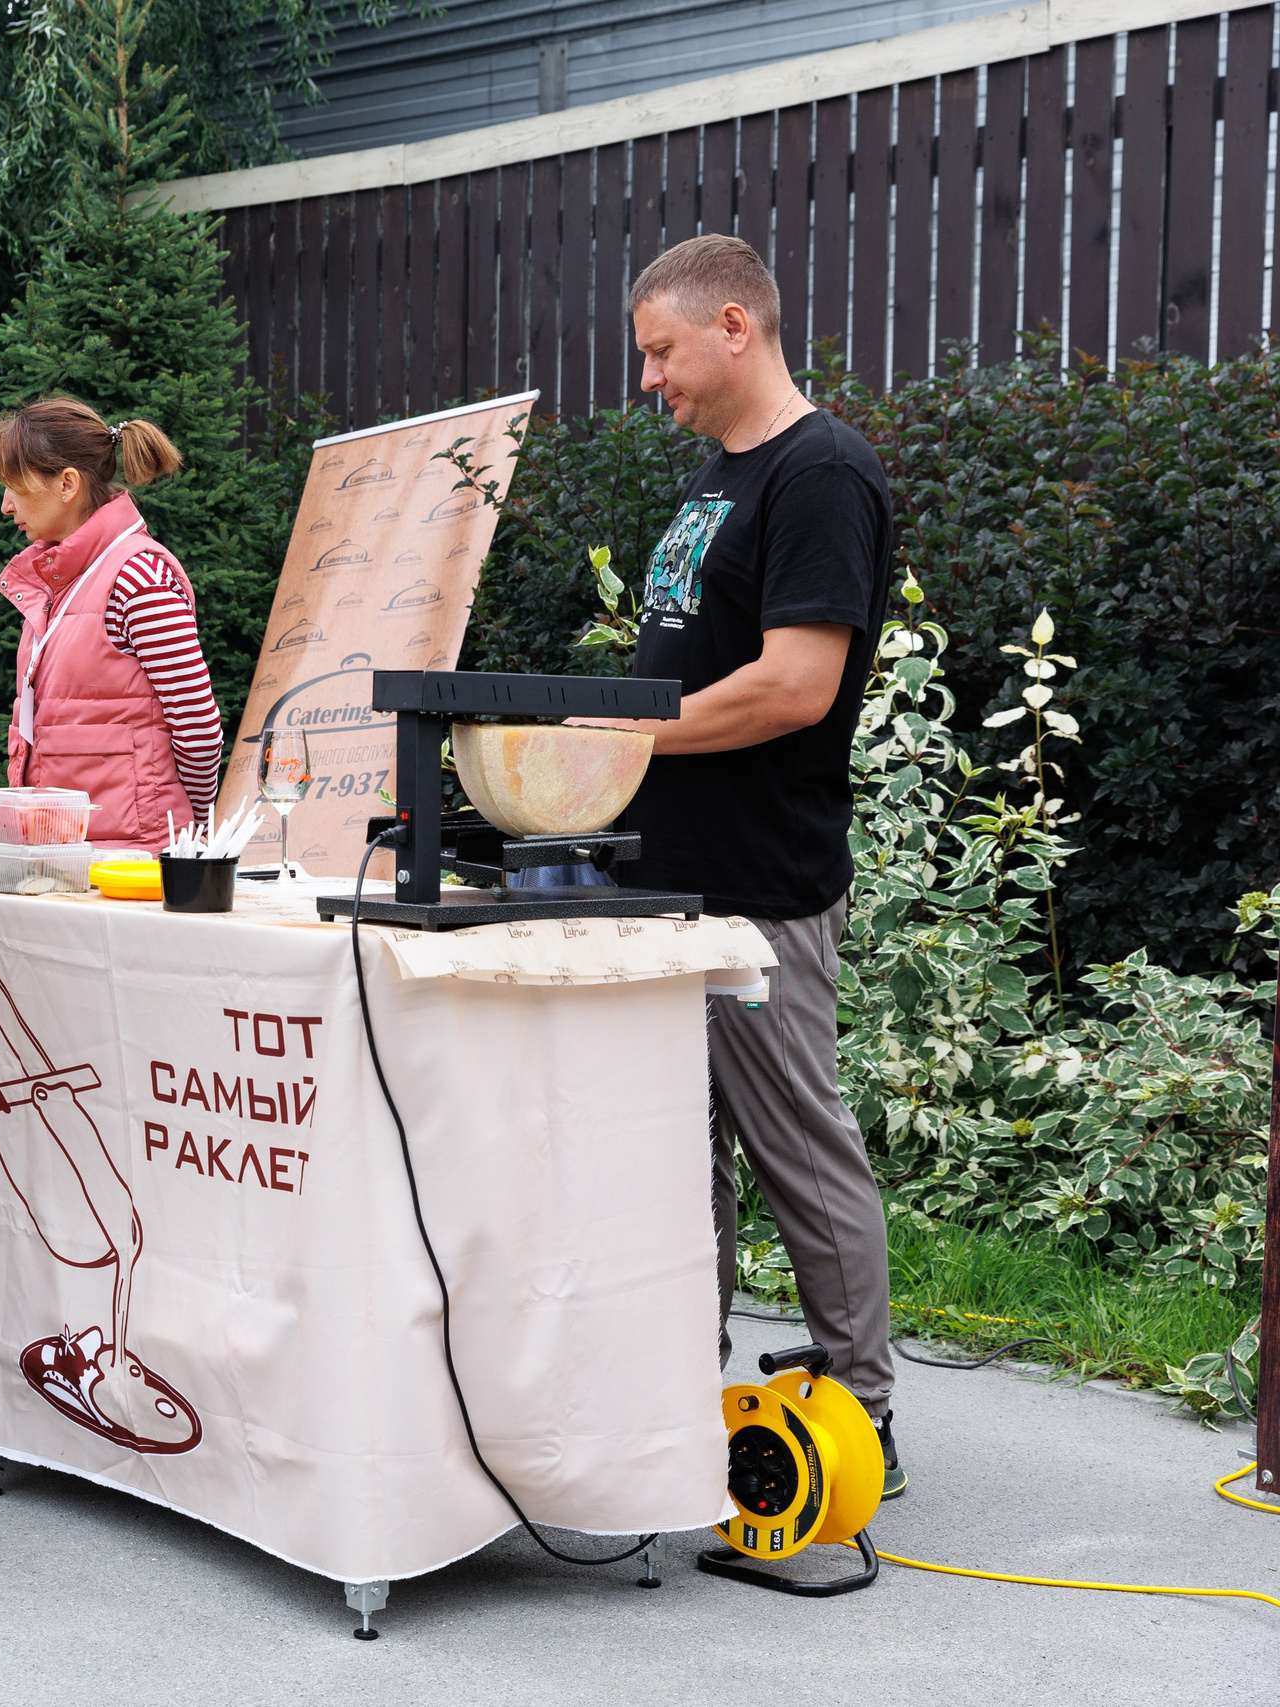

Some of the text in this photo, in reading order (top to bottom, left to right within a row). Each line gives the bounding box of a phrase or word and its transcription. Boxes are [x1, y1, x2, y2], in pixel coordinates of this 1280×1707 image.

[286, 703, 374, 727] Catering
[231, 741, 398, 775] РЕСТО ДНОГО ОБСЛУЖИ
[223, 1007, 323, 1059] ТОТ
[149, 1060, 318, 1128] САМЫЙ
[806, 1443, 817, 1493] INDUSTRIAL
